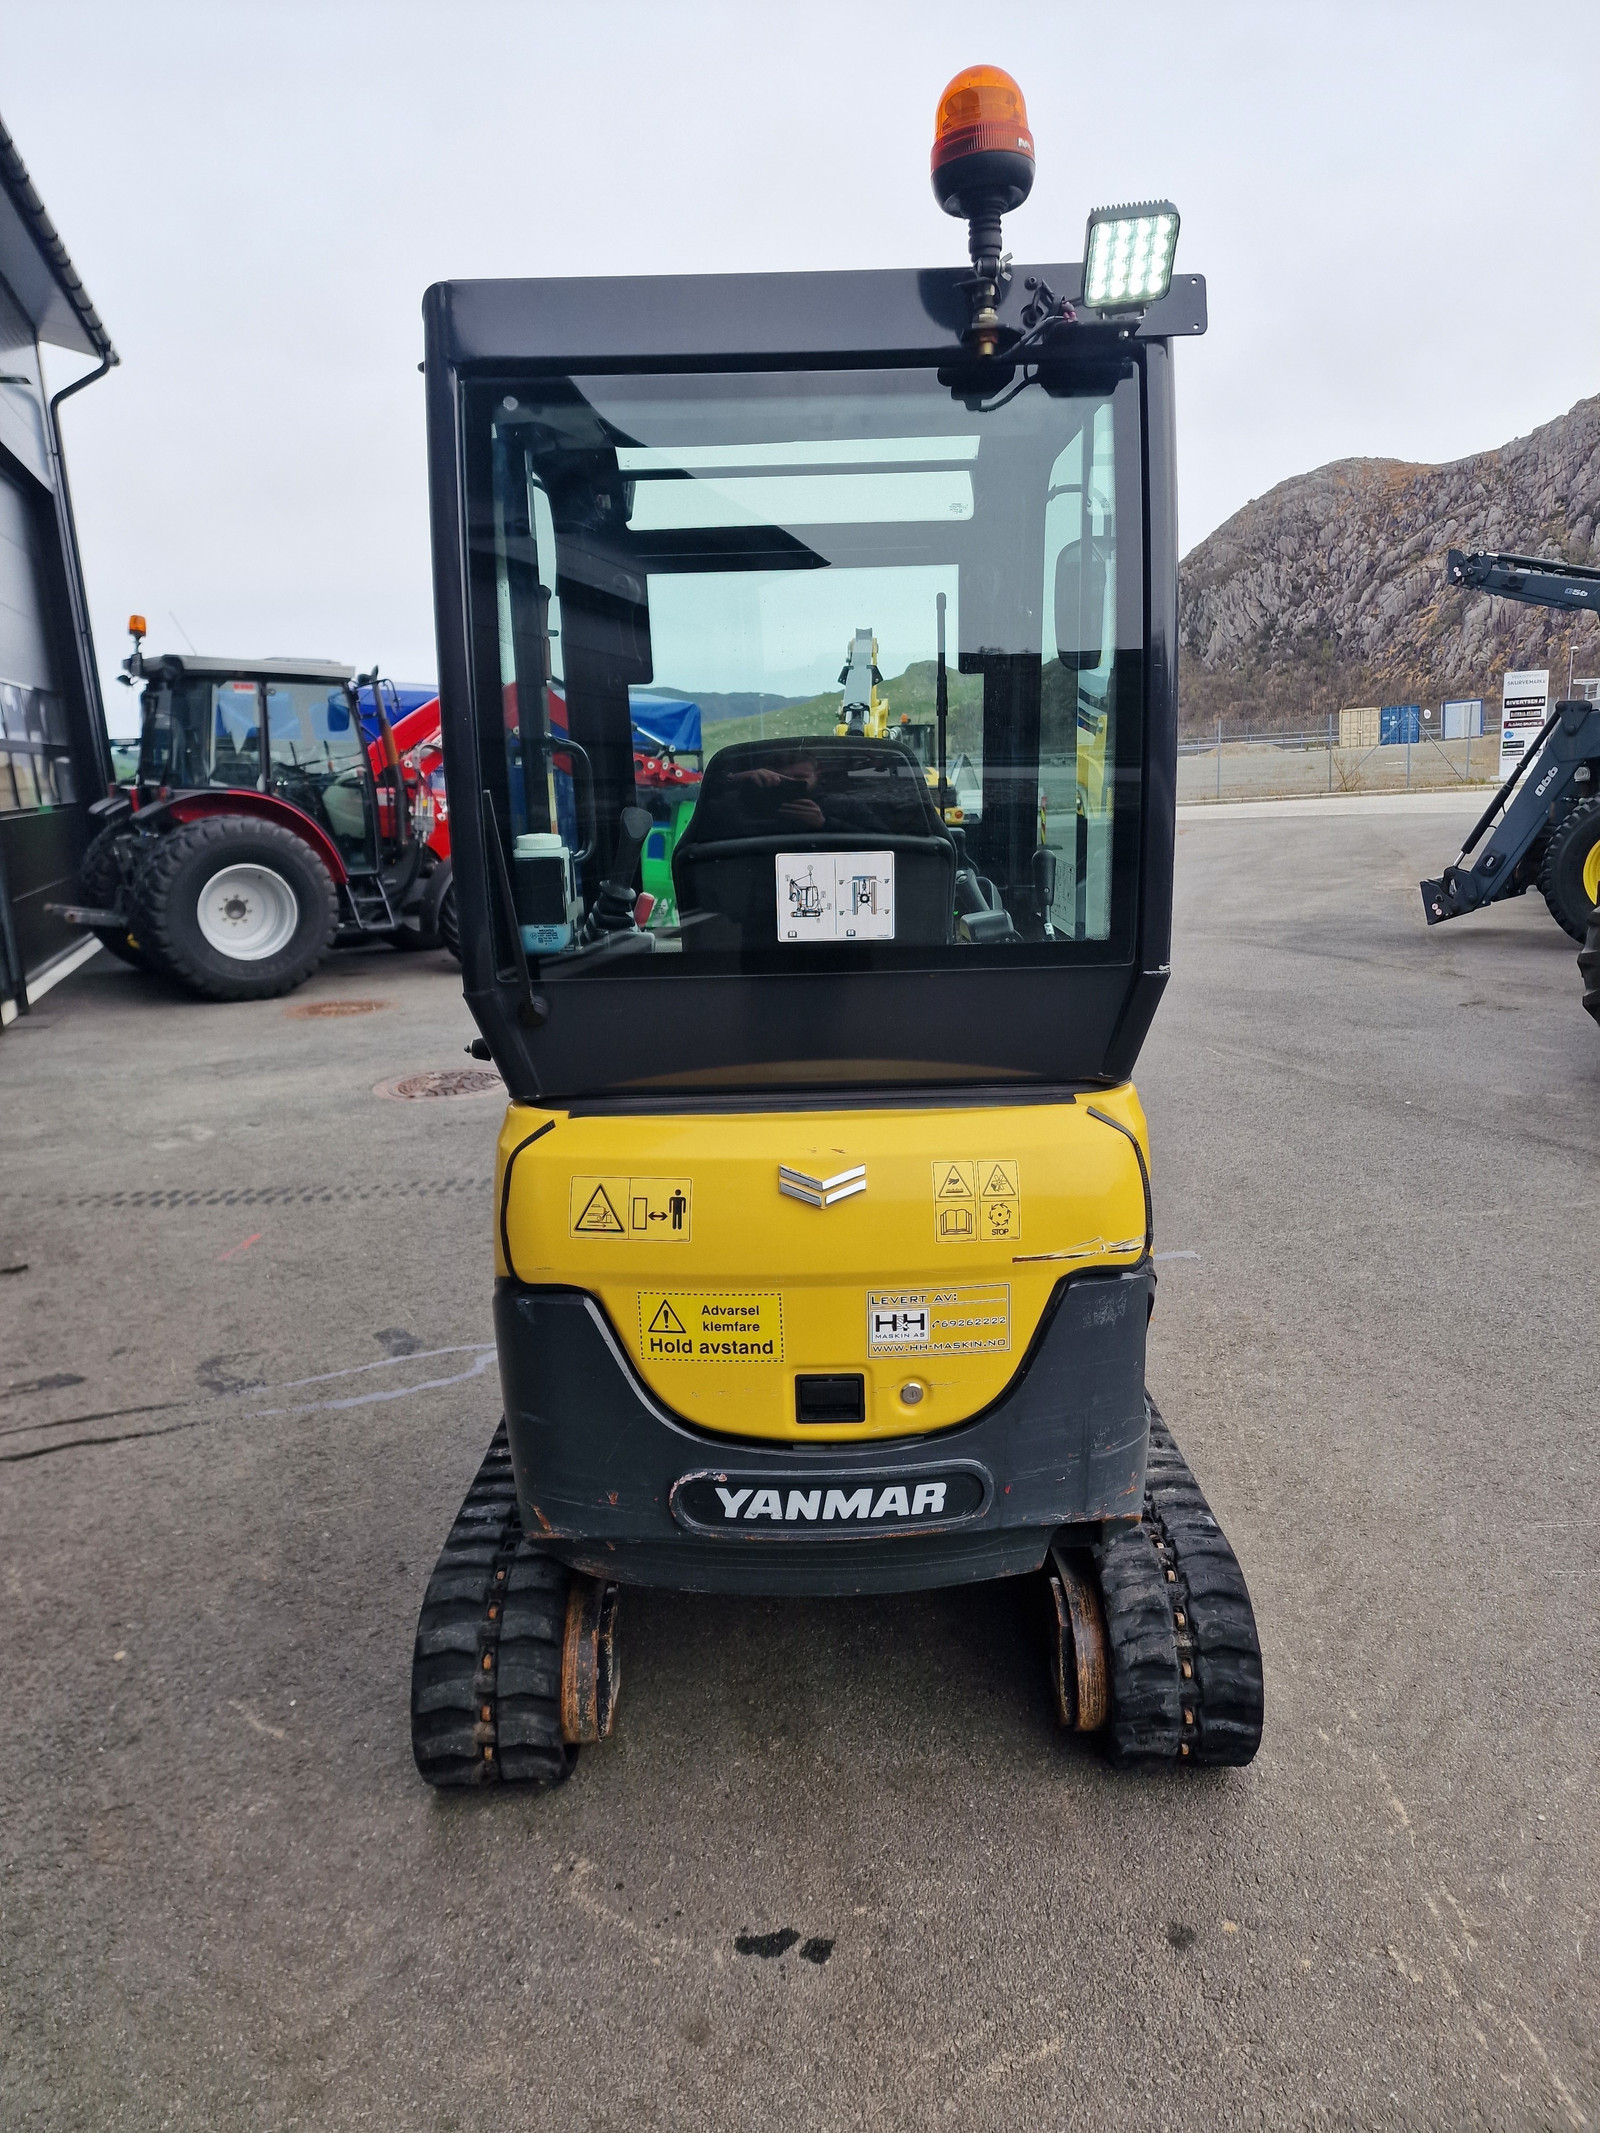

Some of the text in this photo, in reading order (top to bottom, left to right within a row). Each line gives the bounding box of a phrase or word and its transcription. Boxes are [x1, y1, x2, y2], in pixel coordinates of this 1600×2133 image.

[991, 1228, 1009, 1236] STOP
[871, 1293, 958, 1305] LEVERT AV:
[701, 1304, 760, 1316] Advarsel
[702, 1321, 761, 1333] klemfare
[941, 1316, 1006, 1328] 69262222
[650, 1338, 774, 1355] Hold avstand
[715, 1482, 947, 1520] YANMAR
